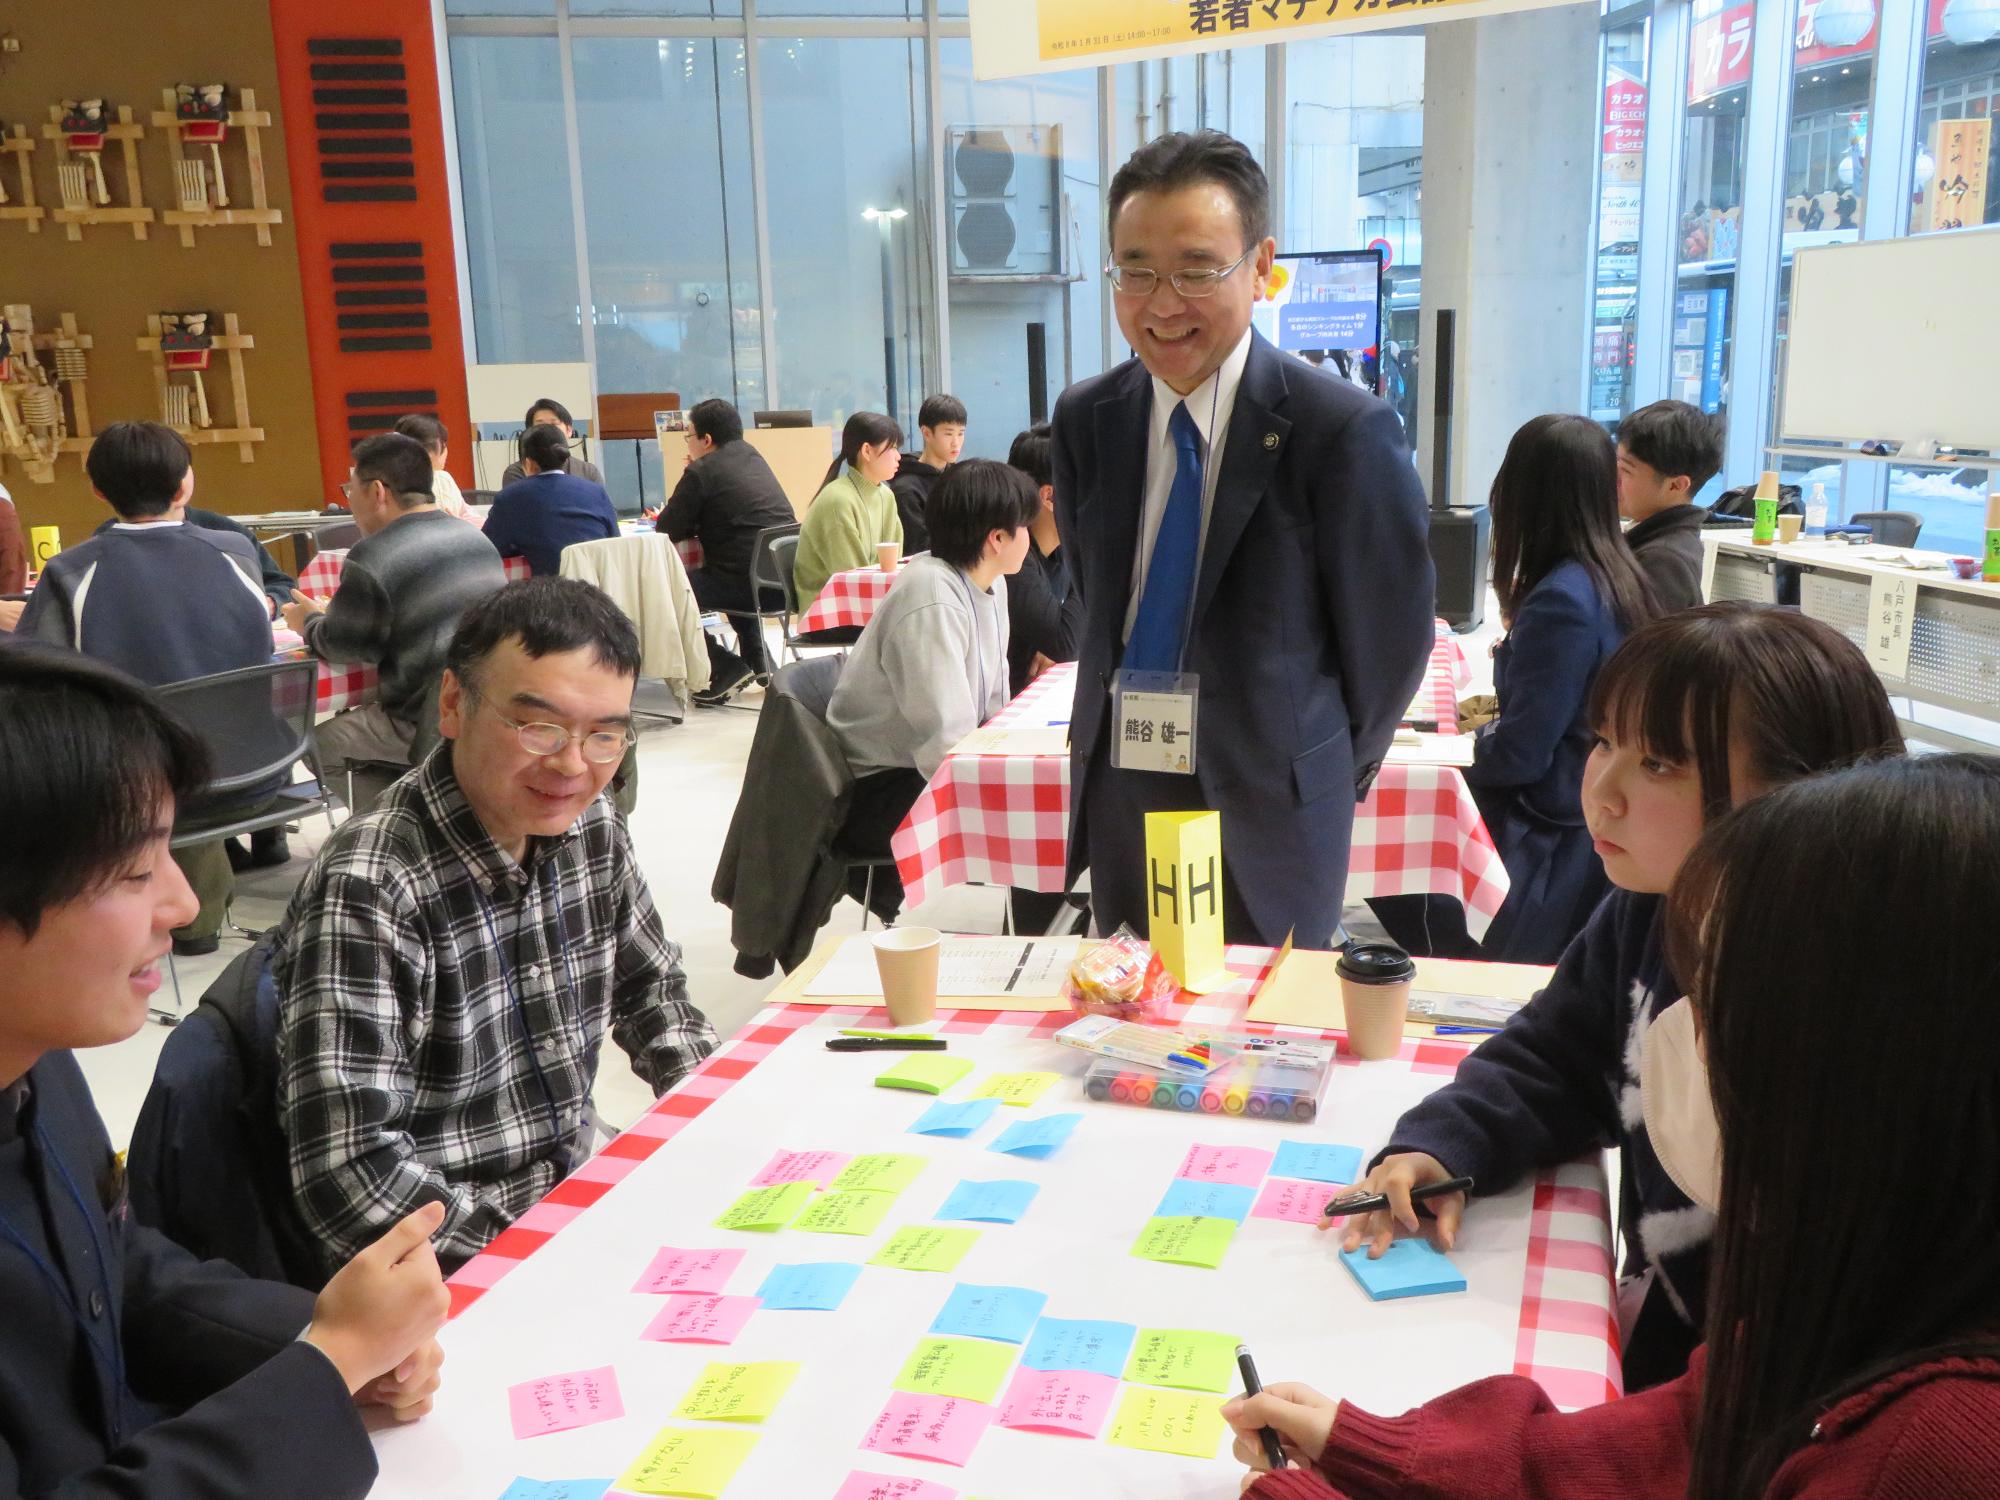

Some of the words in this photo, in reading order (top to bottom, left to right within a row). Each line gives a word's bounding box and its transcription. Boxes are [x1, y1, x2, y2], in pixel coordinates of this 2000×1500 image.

[1615, 128, 1645, 137] カラオ
[1125, 718, 1154, 743] 熊谷
[1161, 721, 1190, 744] 雄一
[1151, 857, 1178, 925] H
[1188, 856, 1215, 924] H
